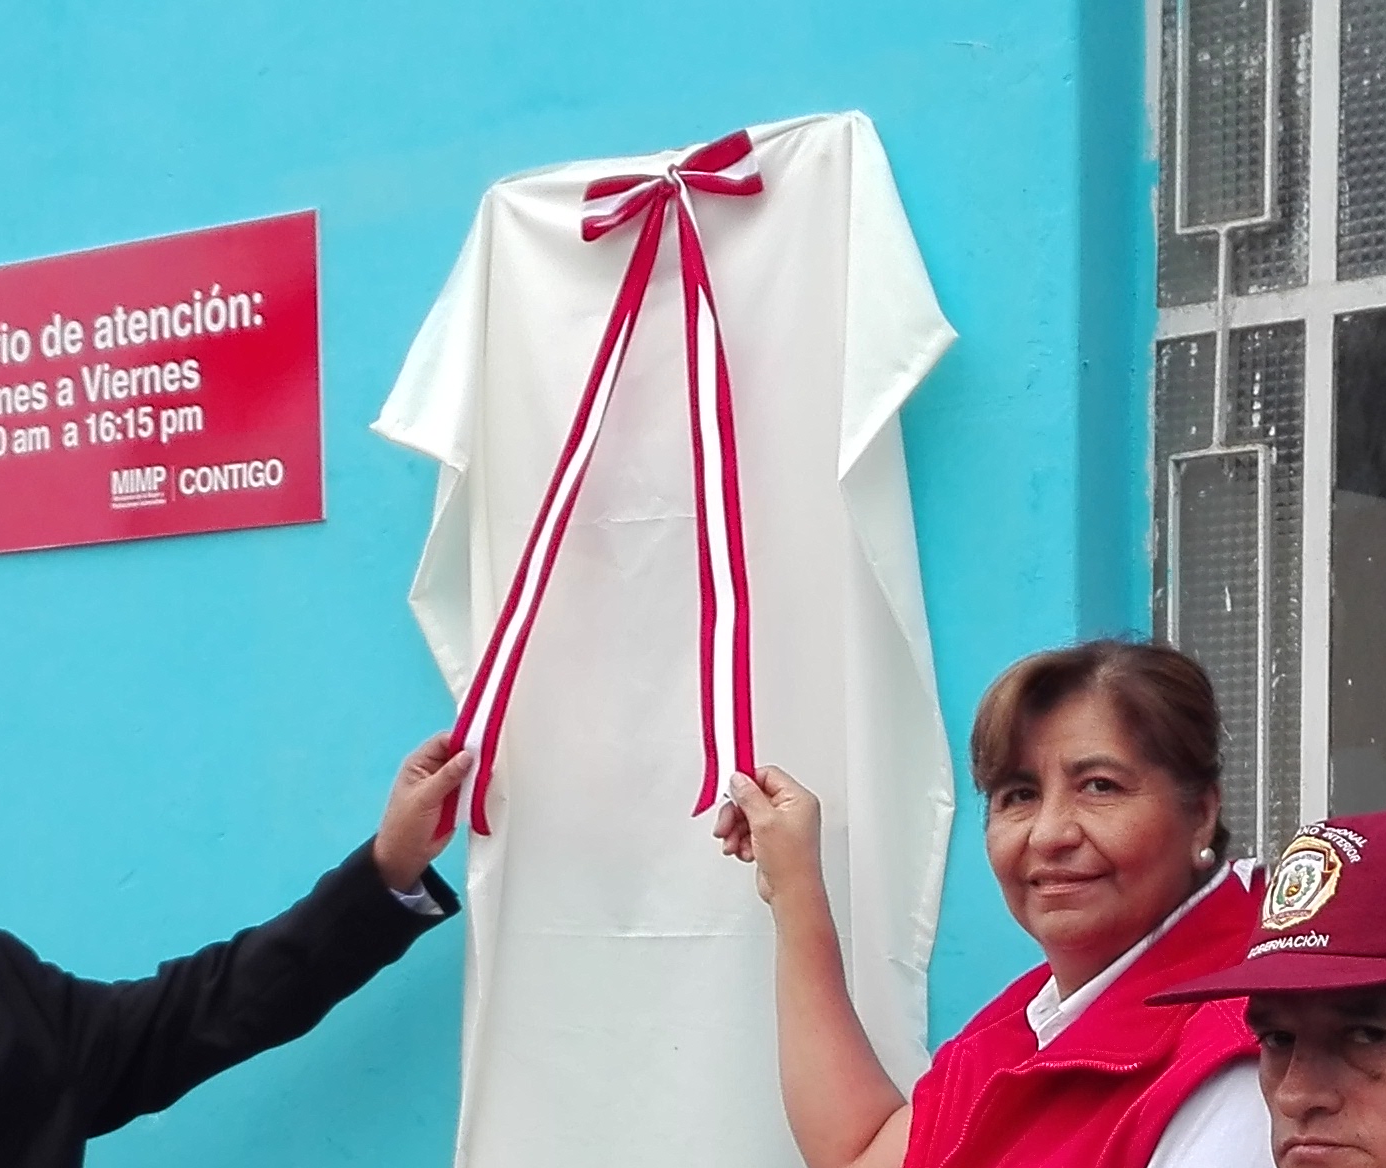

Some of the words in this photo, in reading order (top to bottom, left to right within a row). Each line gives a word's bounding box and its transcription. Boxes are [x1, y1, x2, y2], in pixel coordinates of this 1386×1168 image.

[41, 313, 83, 357] de
[93, 283, 265, 350] atención:
[58, 377, 74, 407] a
[81, 358, 201, 403] Viernes
[13, 422, 50, 454] am
[62, 421, 79, 448] a
[86, 408, 154, 444] 16:15
[159, 404, 203, 443] pm
[110, 465, 167, 496] MIMP
[179, 458, 284, 496] CONTIGO
